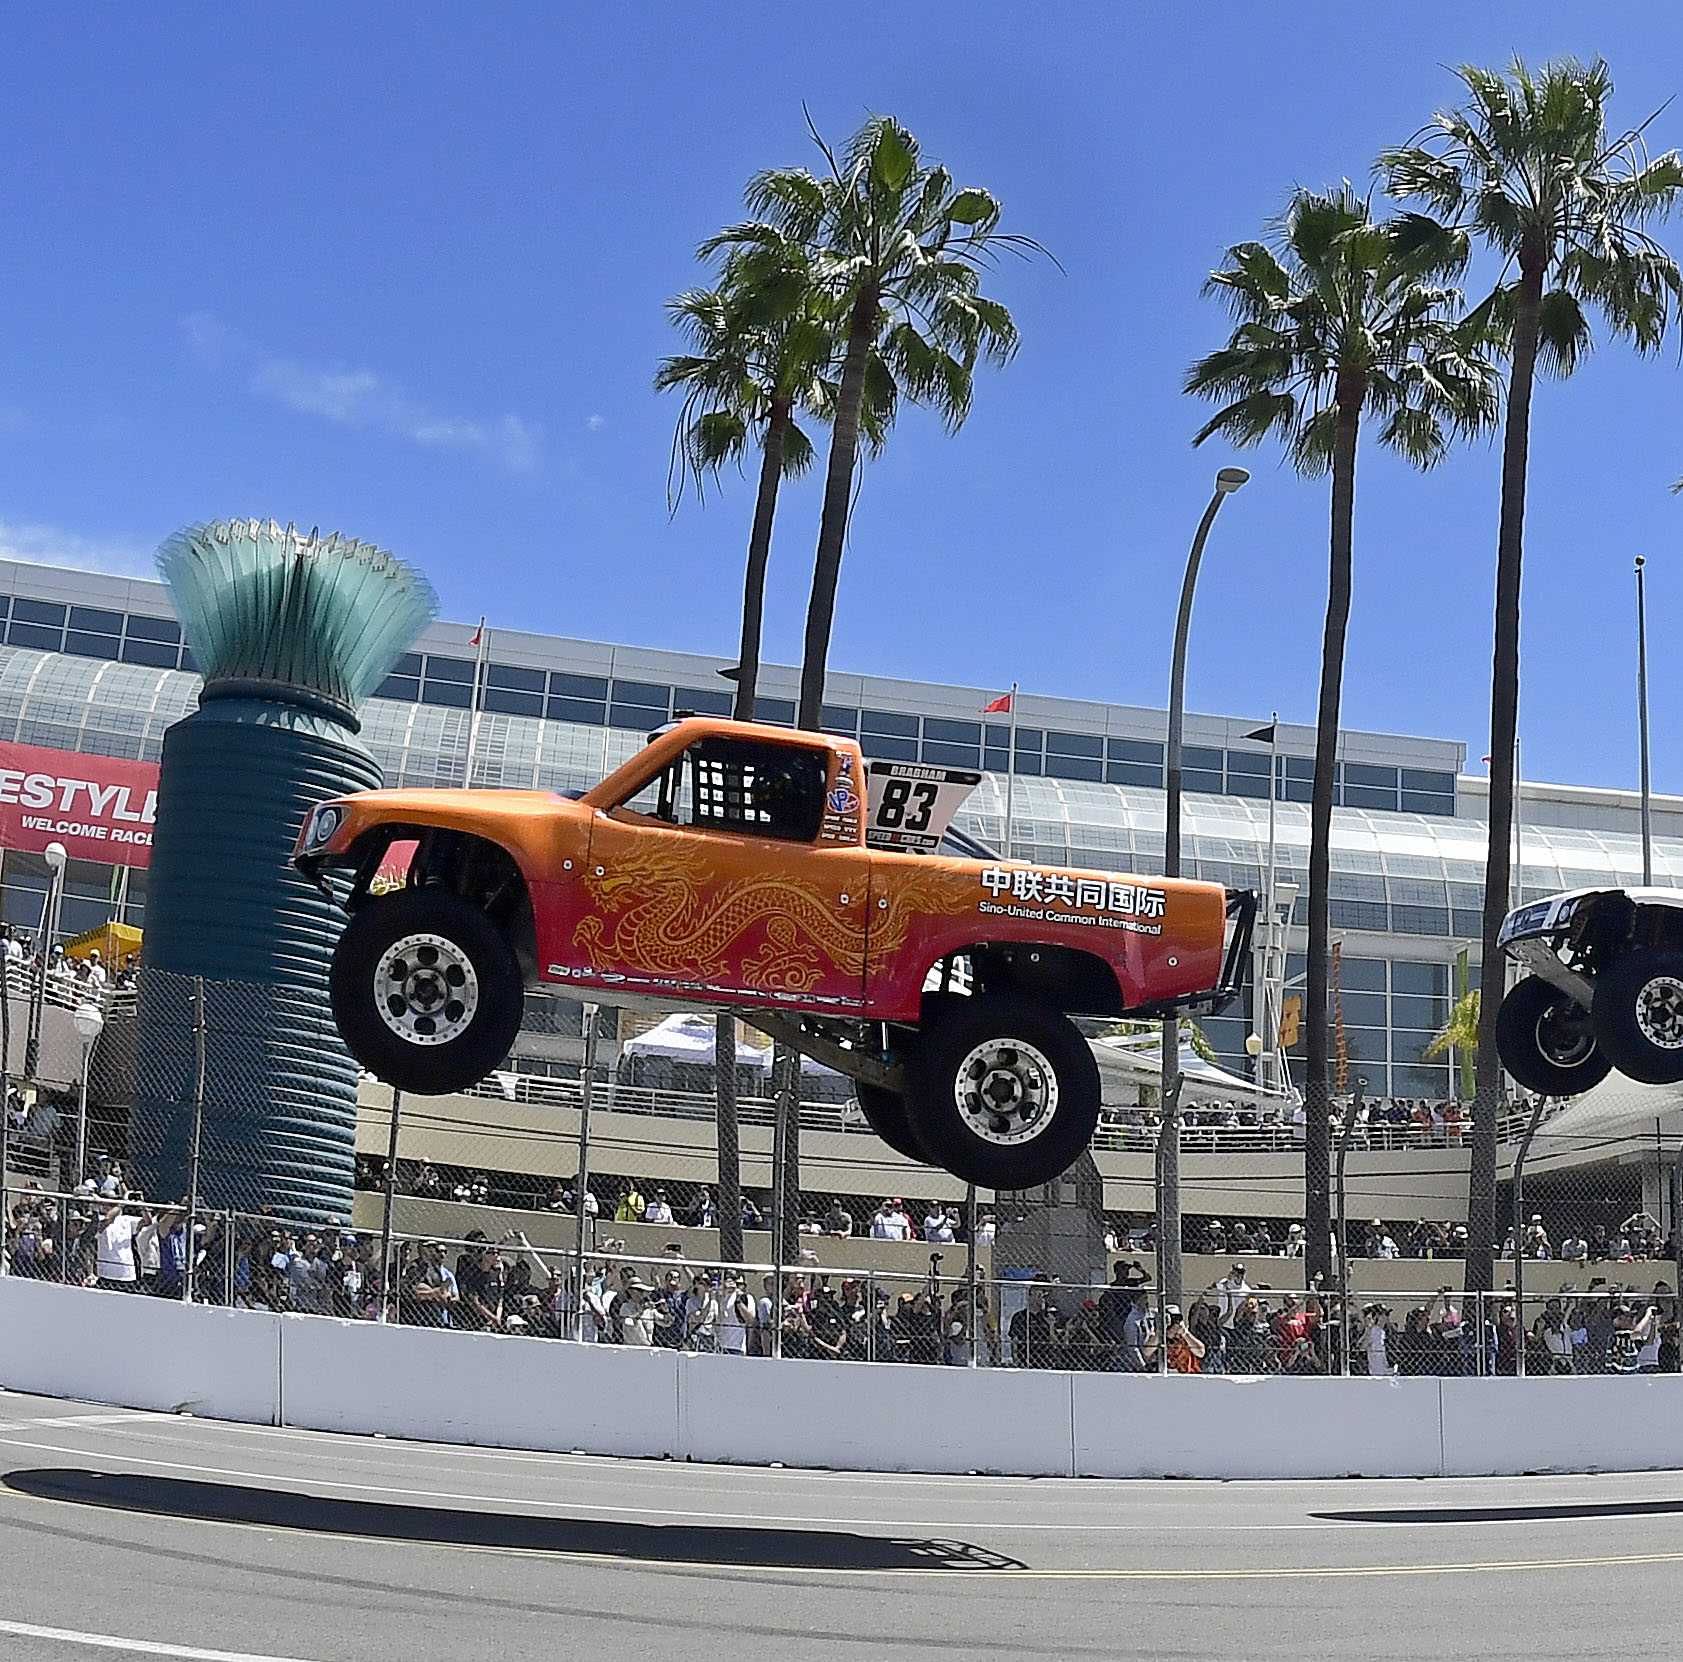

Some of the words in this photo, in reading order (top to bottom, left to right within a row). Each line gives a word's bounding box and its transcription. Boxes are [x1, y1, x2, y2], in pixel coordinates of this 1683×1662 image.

[890, 765, 947, 781] BRABHAM
[876, 779, 939, 831] 83
[22, 815, 109, 839] WELCOME
[981, 867, 1166, 918] 中联共同国际
[979, 901, 1044, 920] Sino-United
[1045, 911, 1096, 926] Common
[1098, 915, 1162, 935] International
